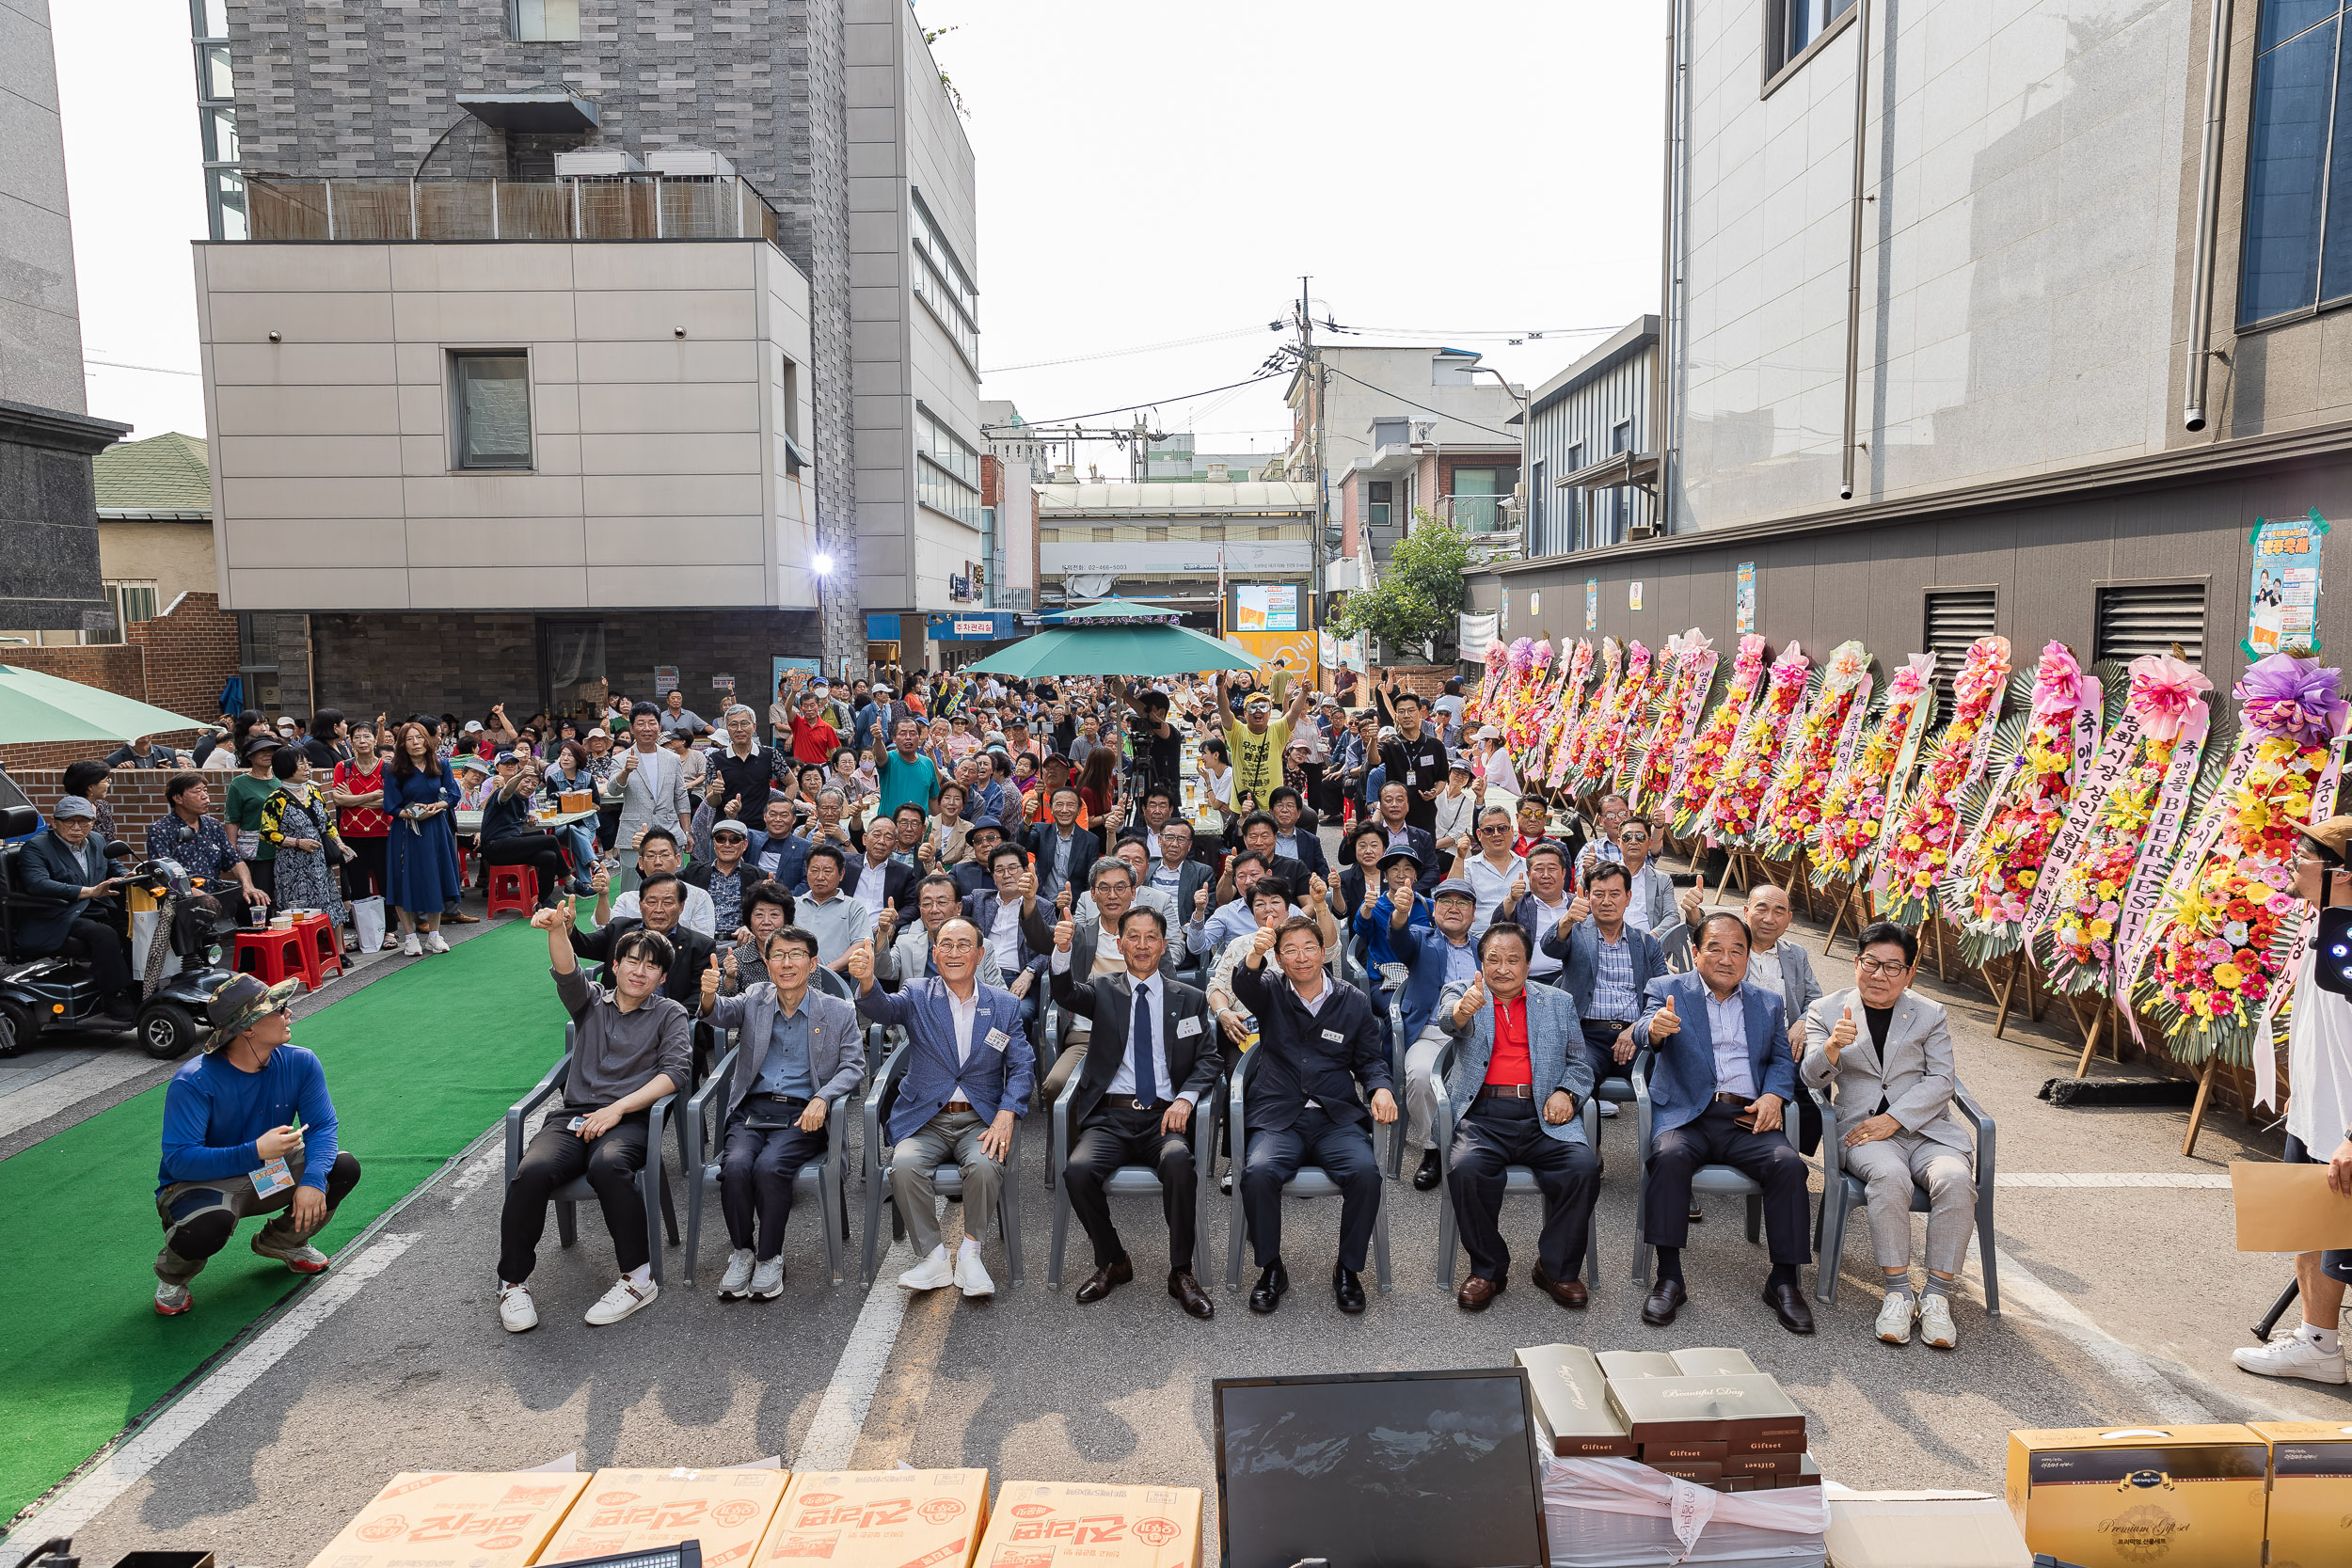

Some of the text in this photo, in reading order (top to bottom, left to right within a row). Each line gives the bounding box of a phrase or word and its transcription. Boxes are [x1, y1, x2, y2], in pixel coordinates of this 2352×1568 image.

[956, 624, 992, 632] 주차관리실
[2077, 709, 2097, 738] 축
[2180, 739, 2199, 755] 축
[2168, 761, 2191, 792] 앵콜
[2147, 797, 2179, 859] BEER
[2118, 862, 2160, 990] FESTIVAL
[254, 1163, 284, 1180] STAFF
[1662, 1386, 1744, 1399] Beautiful Day
[589, 1499, 708, 1530] 진라면
[797, 1498, 914, 1528] 진라면
[926, 1503, 959, 1513] 오뚜기
[1017, 1507, 1047, 1516] 매운맛
[405, 1513, 535, 1543] 진라면
[1010, 1515, 1128, 1545] 진라면
[1139, 1522, 1174, 1534] 오뚜기
[2098, 1516, 2191, 1536] Premium Gift set
